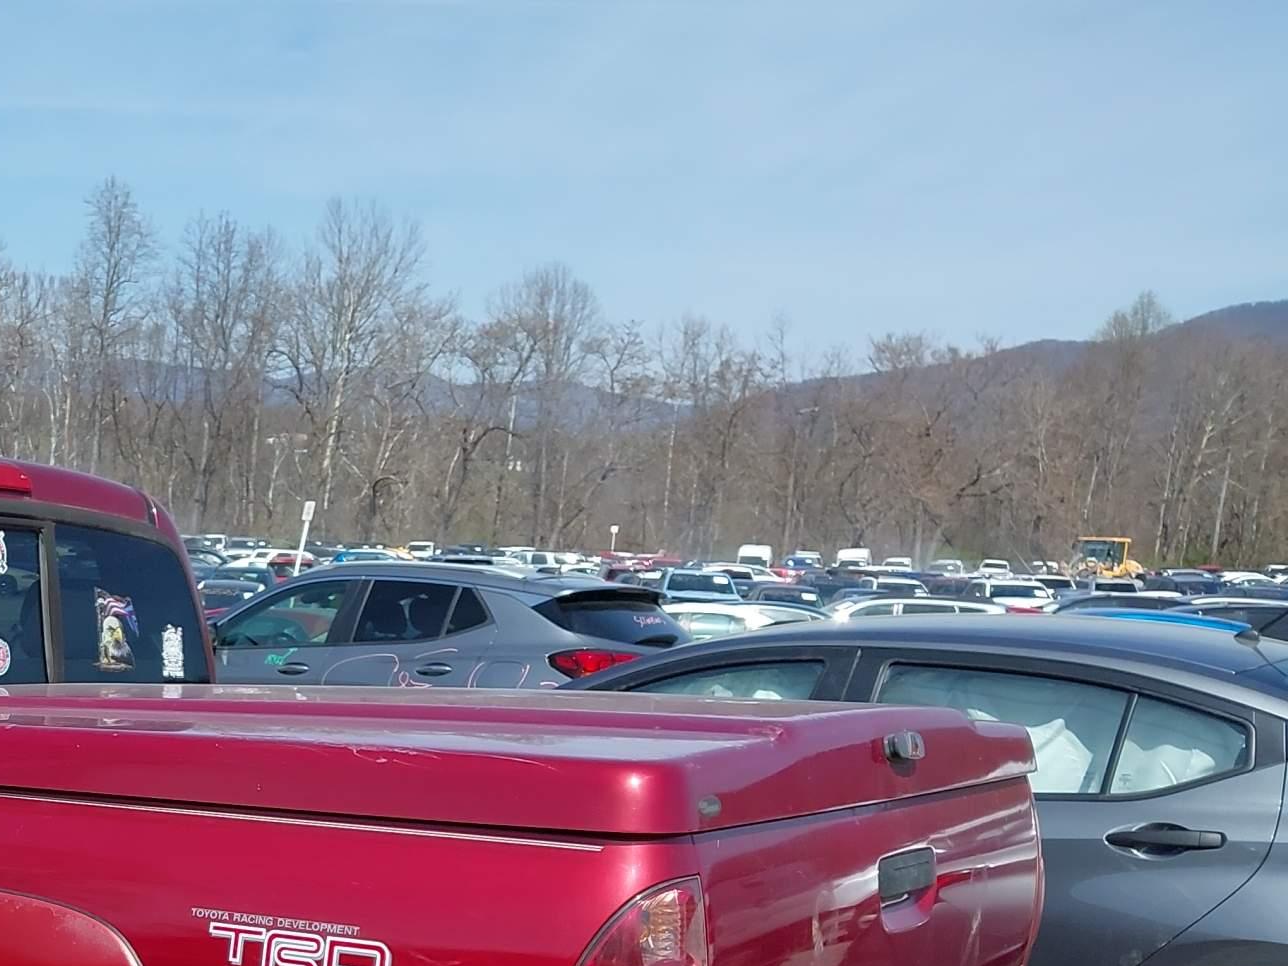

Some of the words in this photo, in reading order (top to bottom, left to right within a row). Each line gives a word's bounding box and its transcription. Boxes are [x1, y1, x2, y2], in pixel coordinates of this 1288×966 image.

[191, 907, 230, 922] TOYOTA
[233, 912, 274, 927] RACING
[277, 917, 360, 936] DEVELOPMENT
